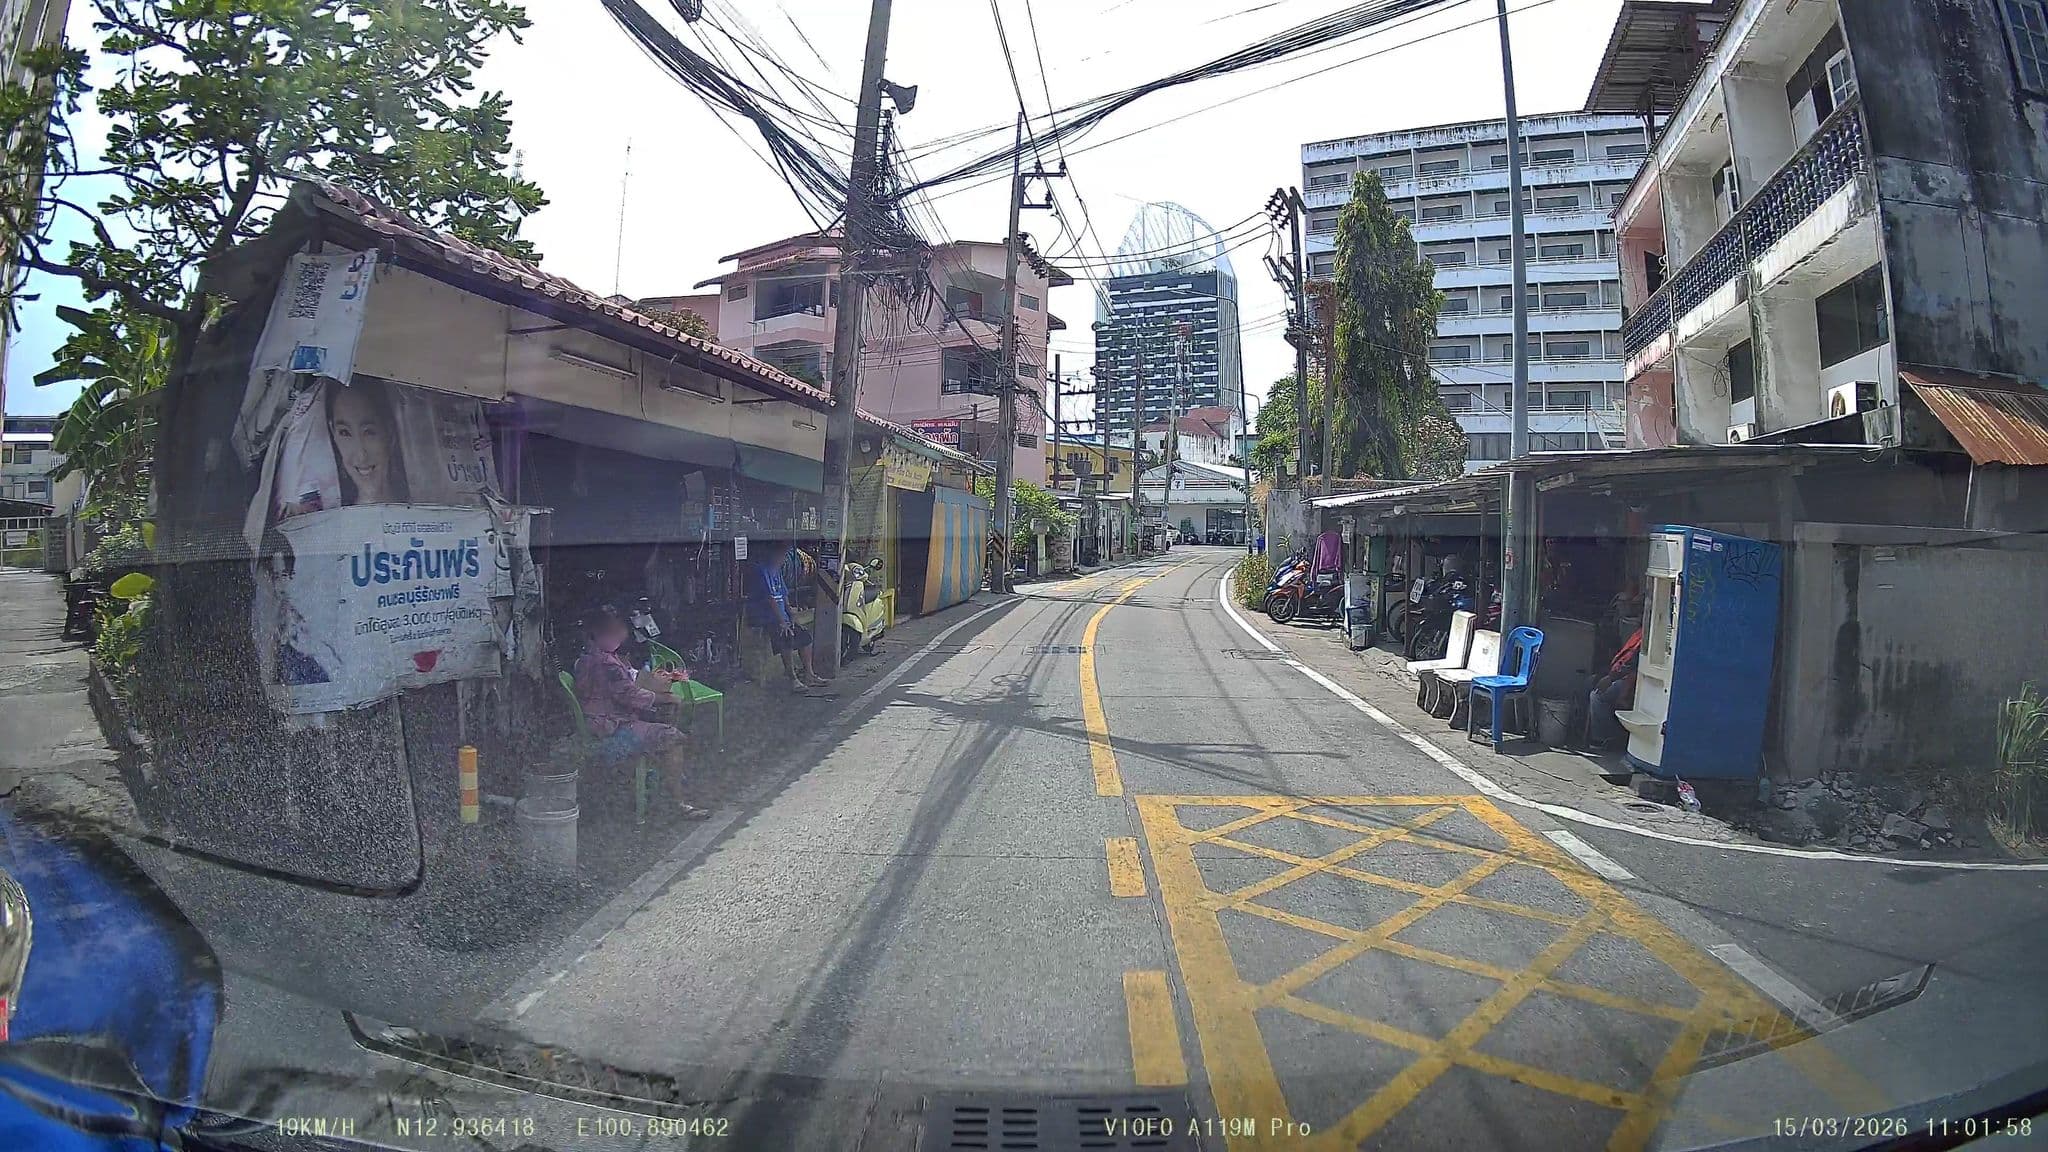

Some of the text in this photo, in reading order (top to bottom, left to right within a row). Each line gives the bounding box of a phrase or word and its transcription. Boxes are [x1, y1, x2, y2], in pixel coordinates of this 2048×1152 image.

[917, 427, 959, 443] ้องพัก
[351, 536, 480, 587] ประกันฟรี
